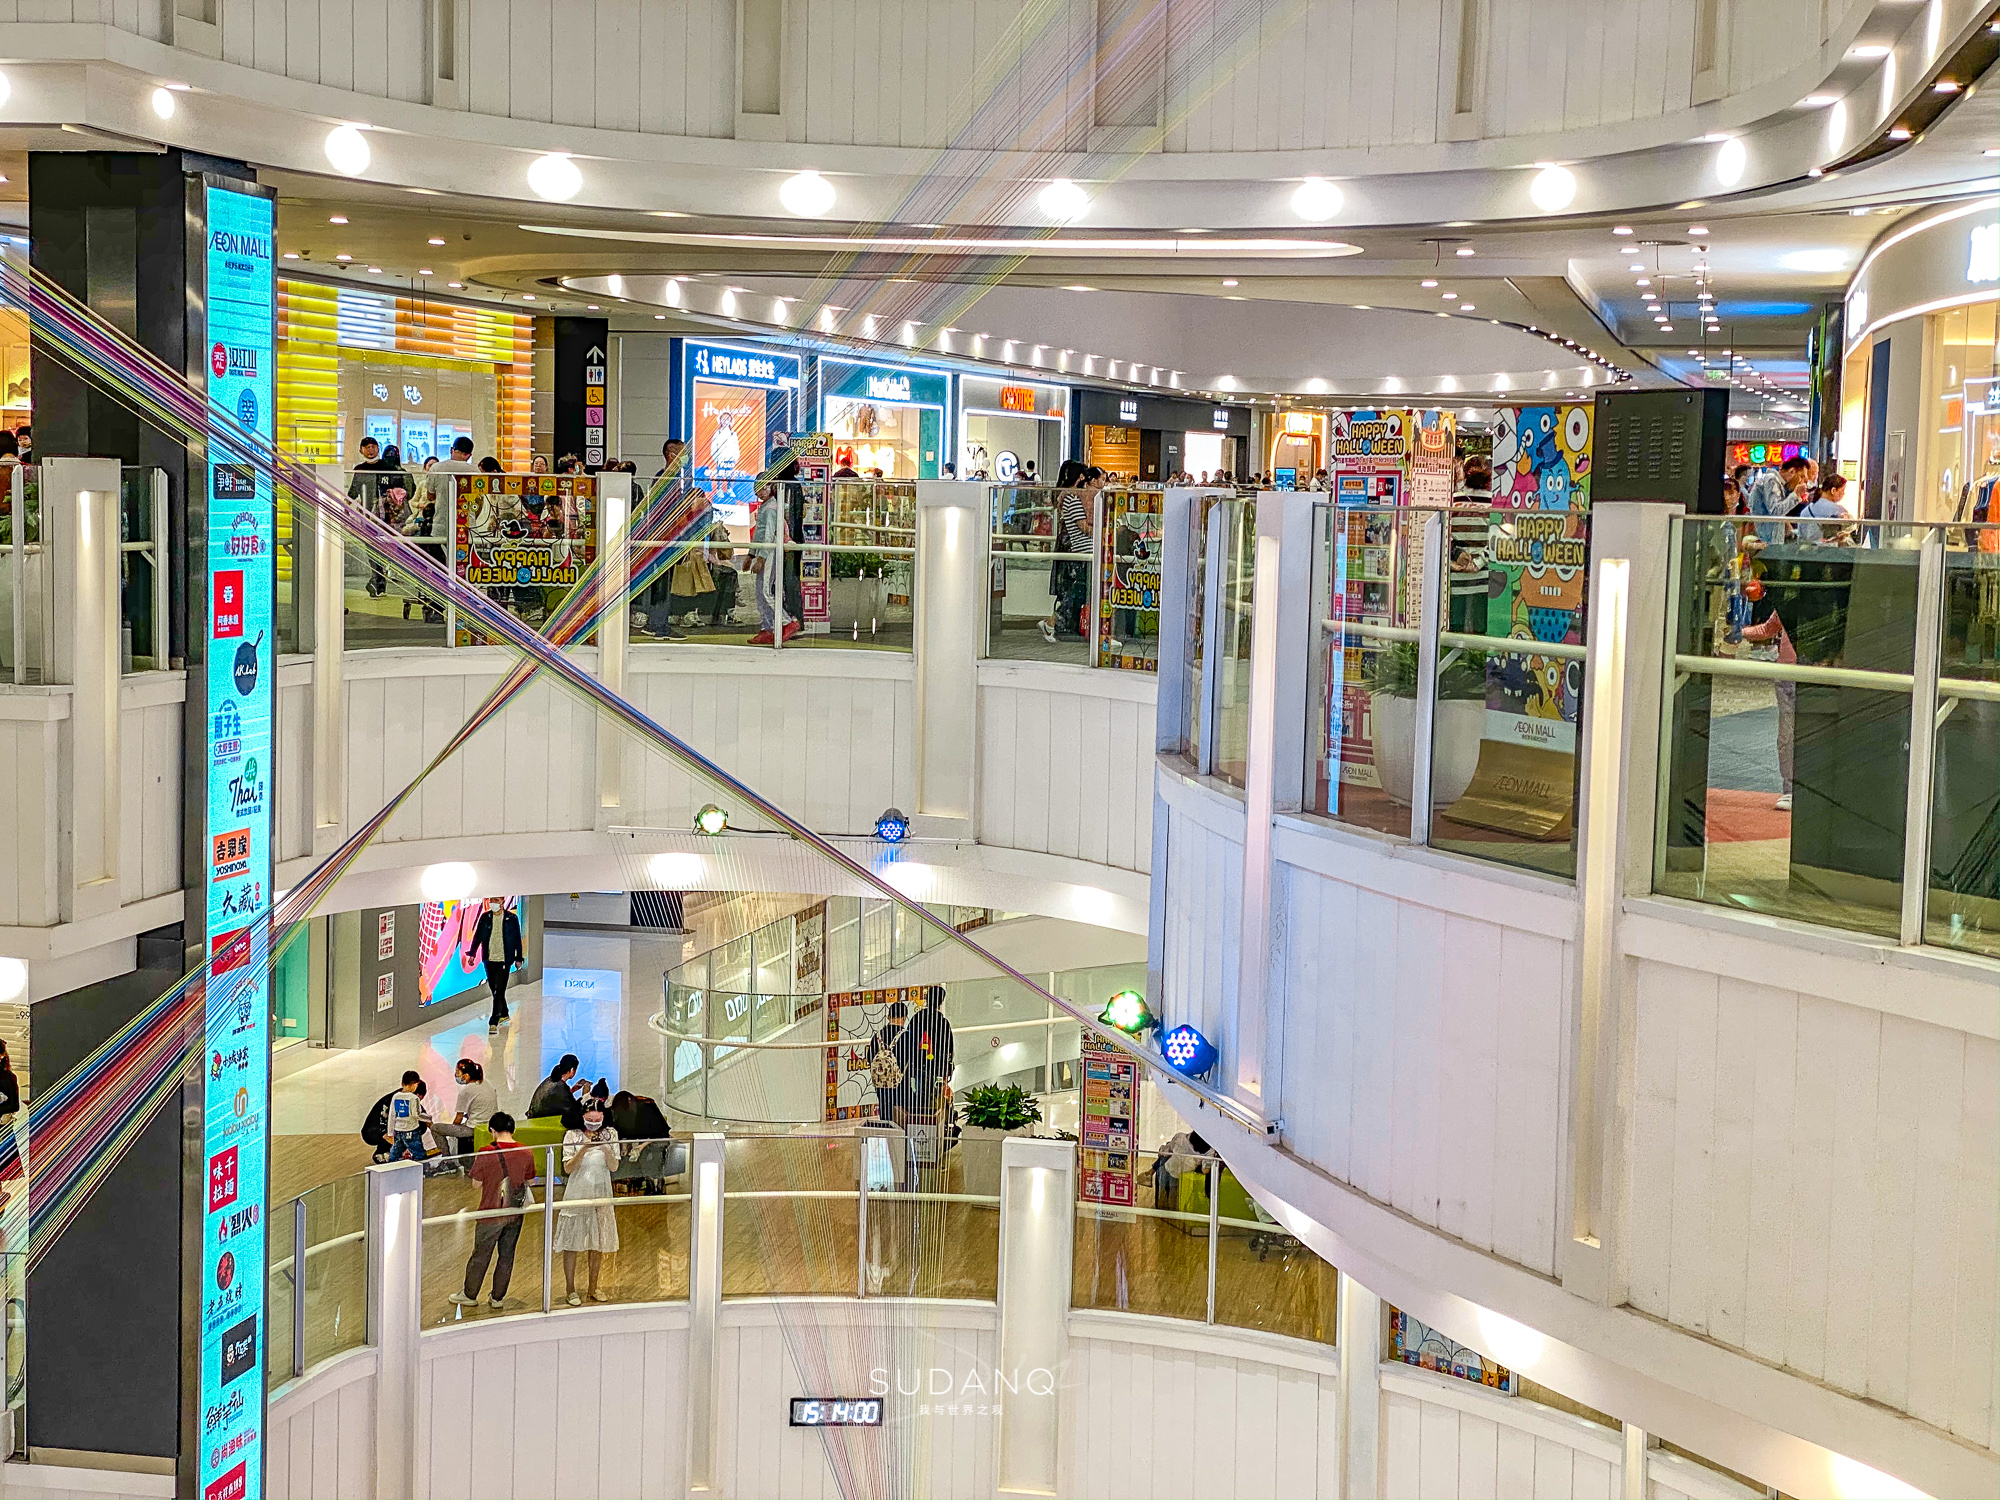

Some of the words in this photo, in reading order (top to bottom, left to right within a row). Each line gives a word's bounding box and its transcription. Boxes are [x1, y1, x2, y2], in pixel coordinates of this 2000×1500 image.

[241, 235, 269, 259] MALL
[1351, 422, 1388, 438] HAPPY
[1336, 438, 1404, 455] HALLOWEEN
[1517, 516, 1564, 540] HAPPY
[1496, 537, 1584, 565] HALLOWEEN
[1535, 724, 1556, 738] MALL
[1358, 767, 1373, 777] MALL
[228, 775, 258, 812] Thai
[1522, 779, 1551, 798] MALL
[217, 834, 247, 861] 吉野家
